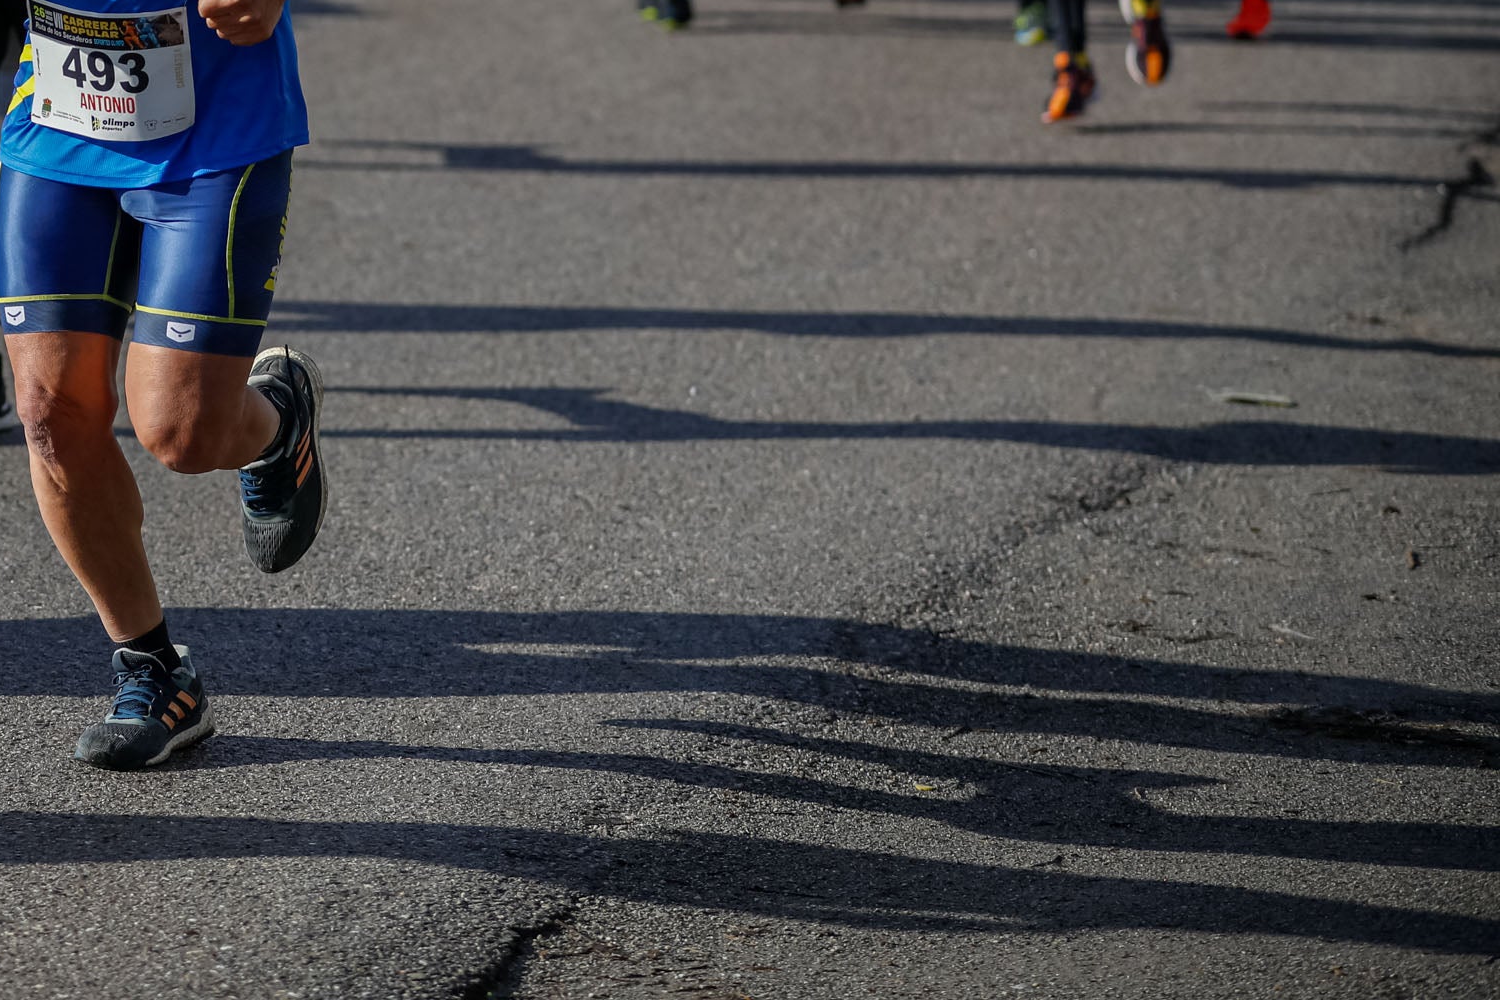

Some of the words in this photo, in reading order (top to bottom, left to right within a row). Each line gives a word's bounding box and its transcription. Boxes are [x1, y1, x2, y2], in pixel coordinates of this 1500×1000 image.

[33, 5, 45, 18] 26
[62, 14, 118, 31] CARRERA
[47, 26, 53, 34] de
[54, 28, 62, 37] los
[63, 31, 93, 44] Secaderos
[64, 24, 119, 39] POPULAR
[62, 47, 149, 94] 493
[80, 93, 136, 114] ANTONIO
[102, 118, 135, 128] olimpo
